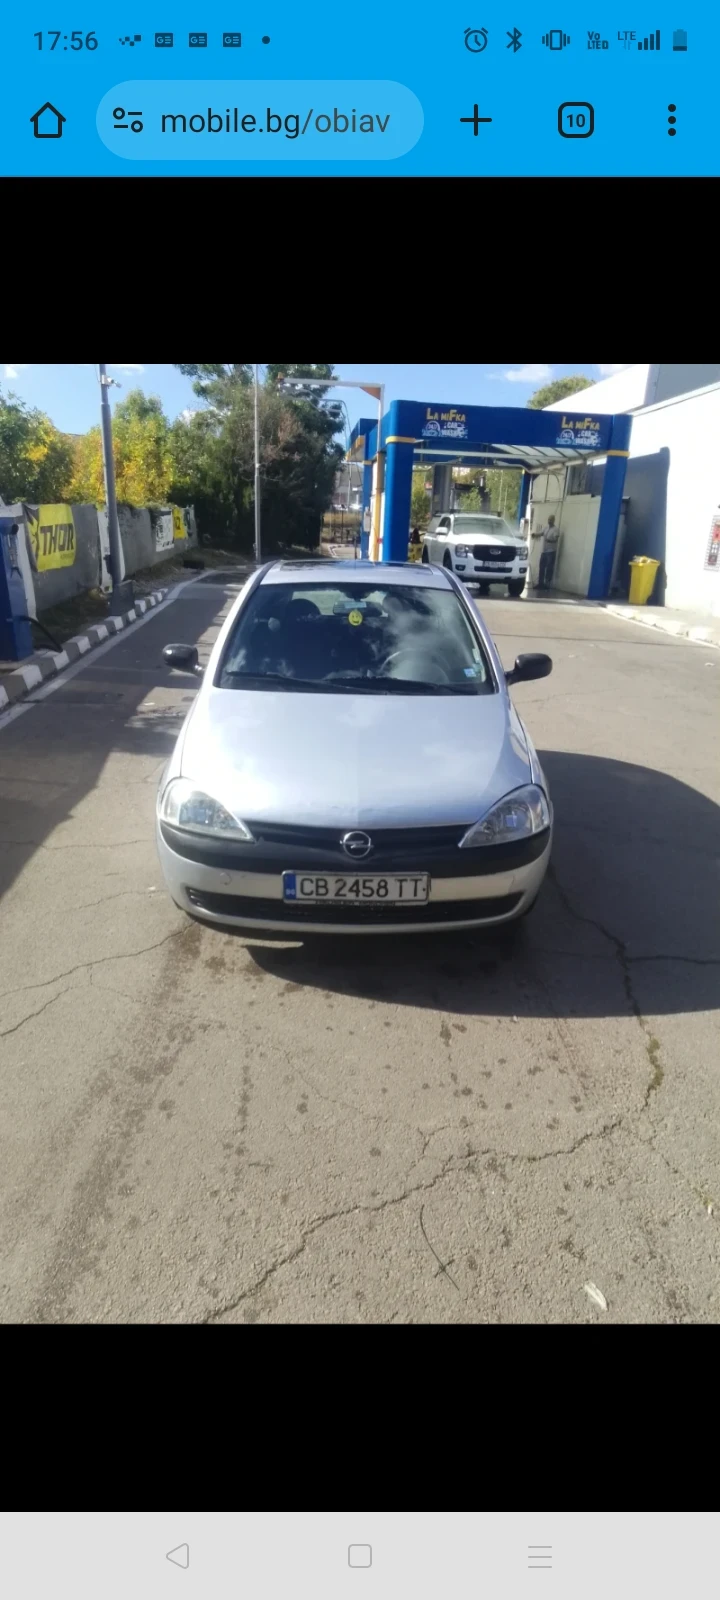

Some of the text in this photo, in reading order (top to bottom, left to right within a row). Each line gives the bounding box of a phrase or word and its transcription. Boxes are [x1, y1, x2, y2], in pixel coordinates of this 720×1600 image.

[40, 523, 74, 556] THOR
[300, 878, 329, 896] CB
[334, 878, 389, 898] 2458
[395, 878, 422, 897] TT
